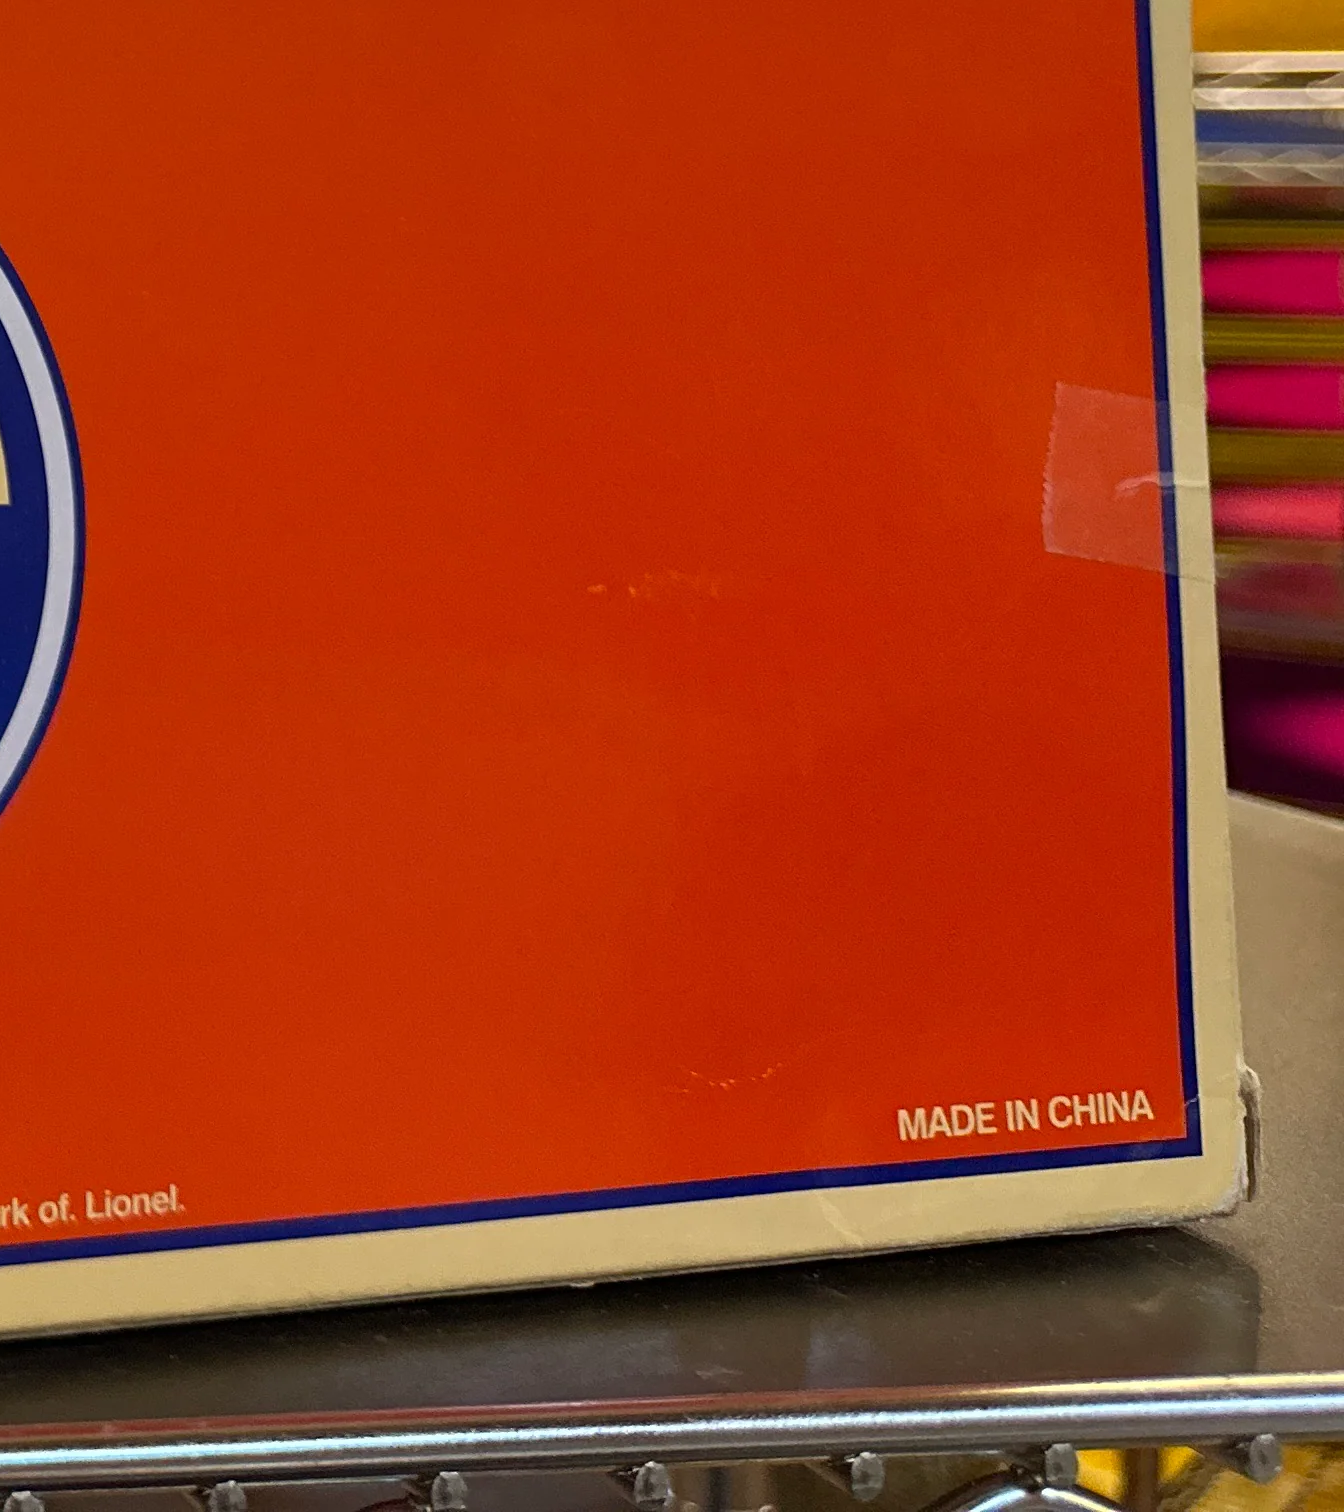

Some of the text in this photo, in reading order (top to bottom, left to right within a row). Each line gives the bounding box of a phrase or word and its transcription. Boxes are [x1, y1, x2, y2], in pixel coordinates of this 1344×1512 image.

[897, 1089, 1154, 1141] MADE IN CHINA
[85, 1183, 185, 1220] Lionel.
